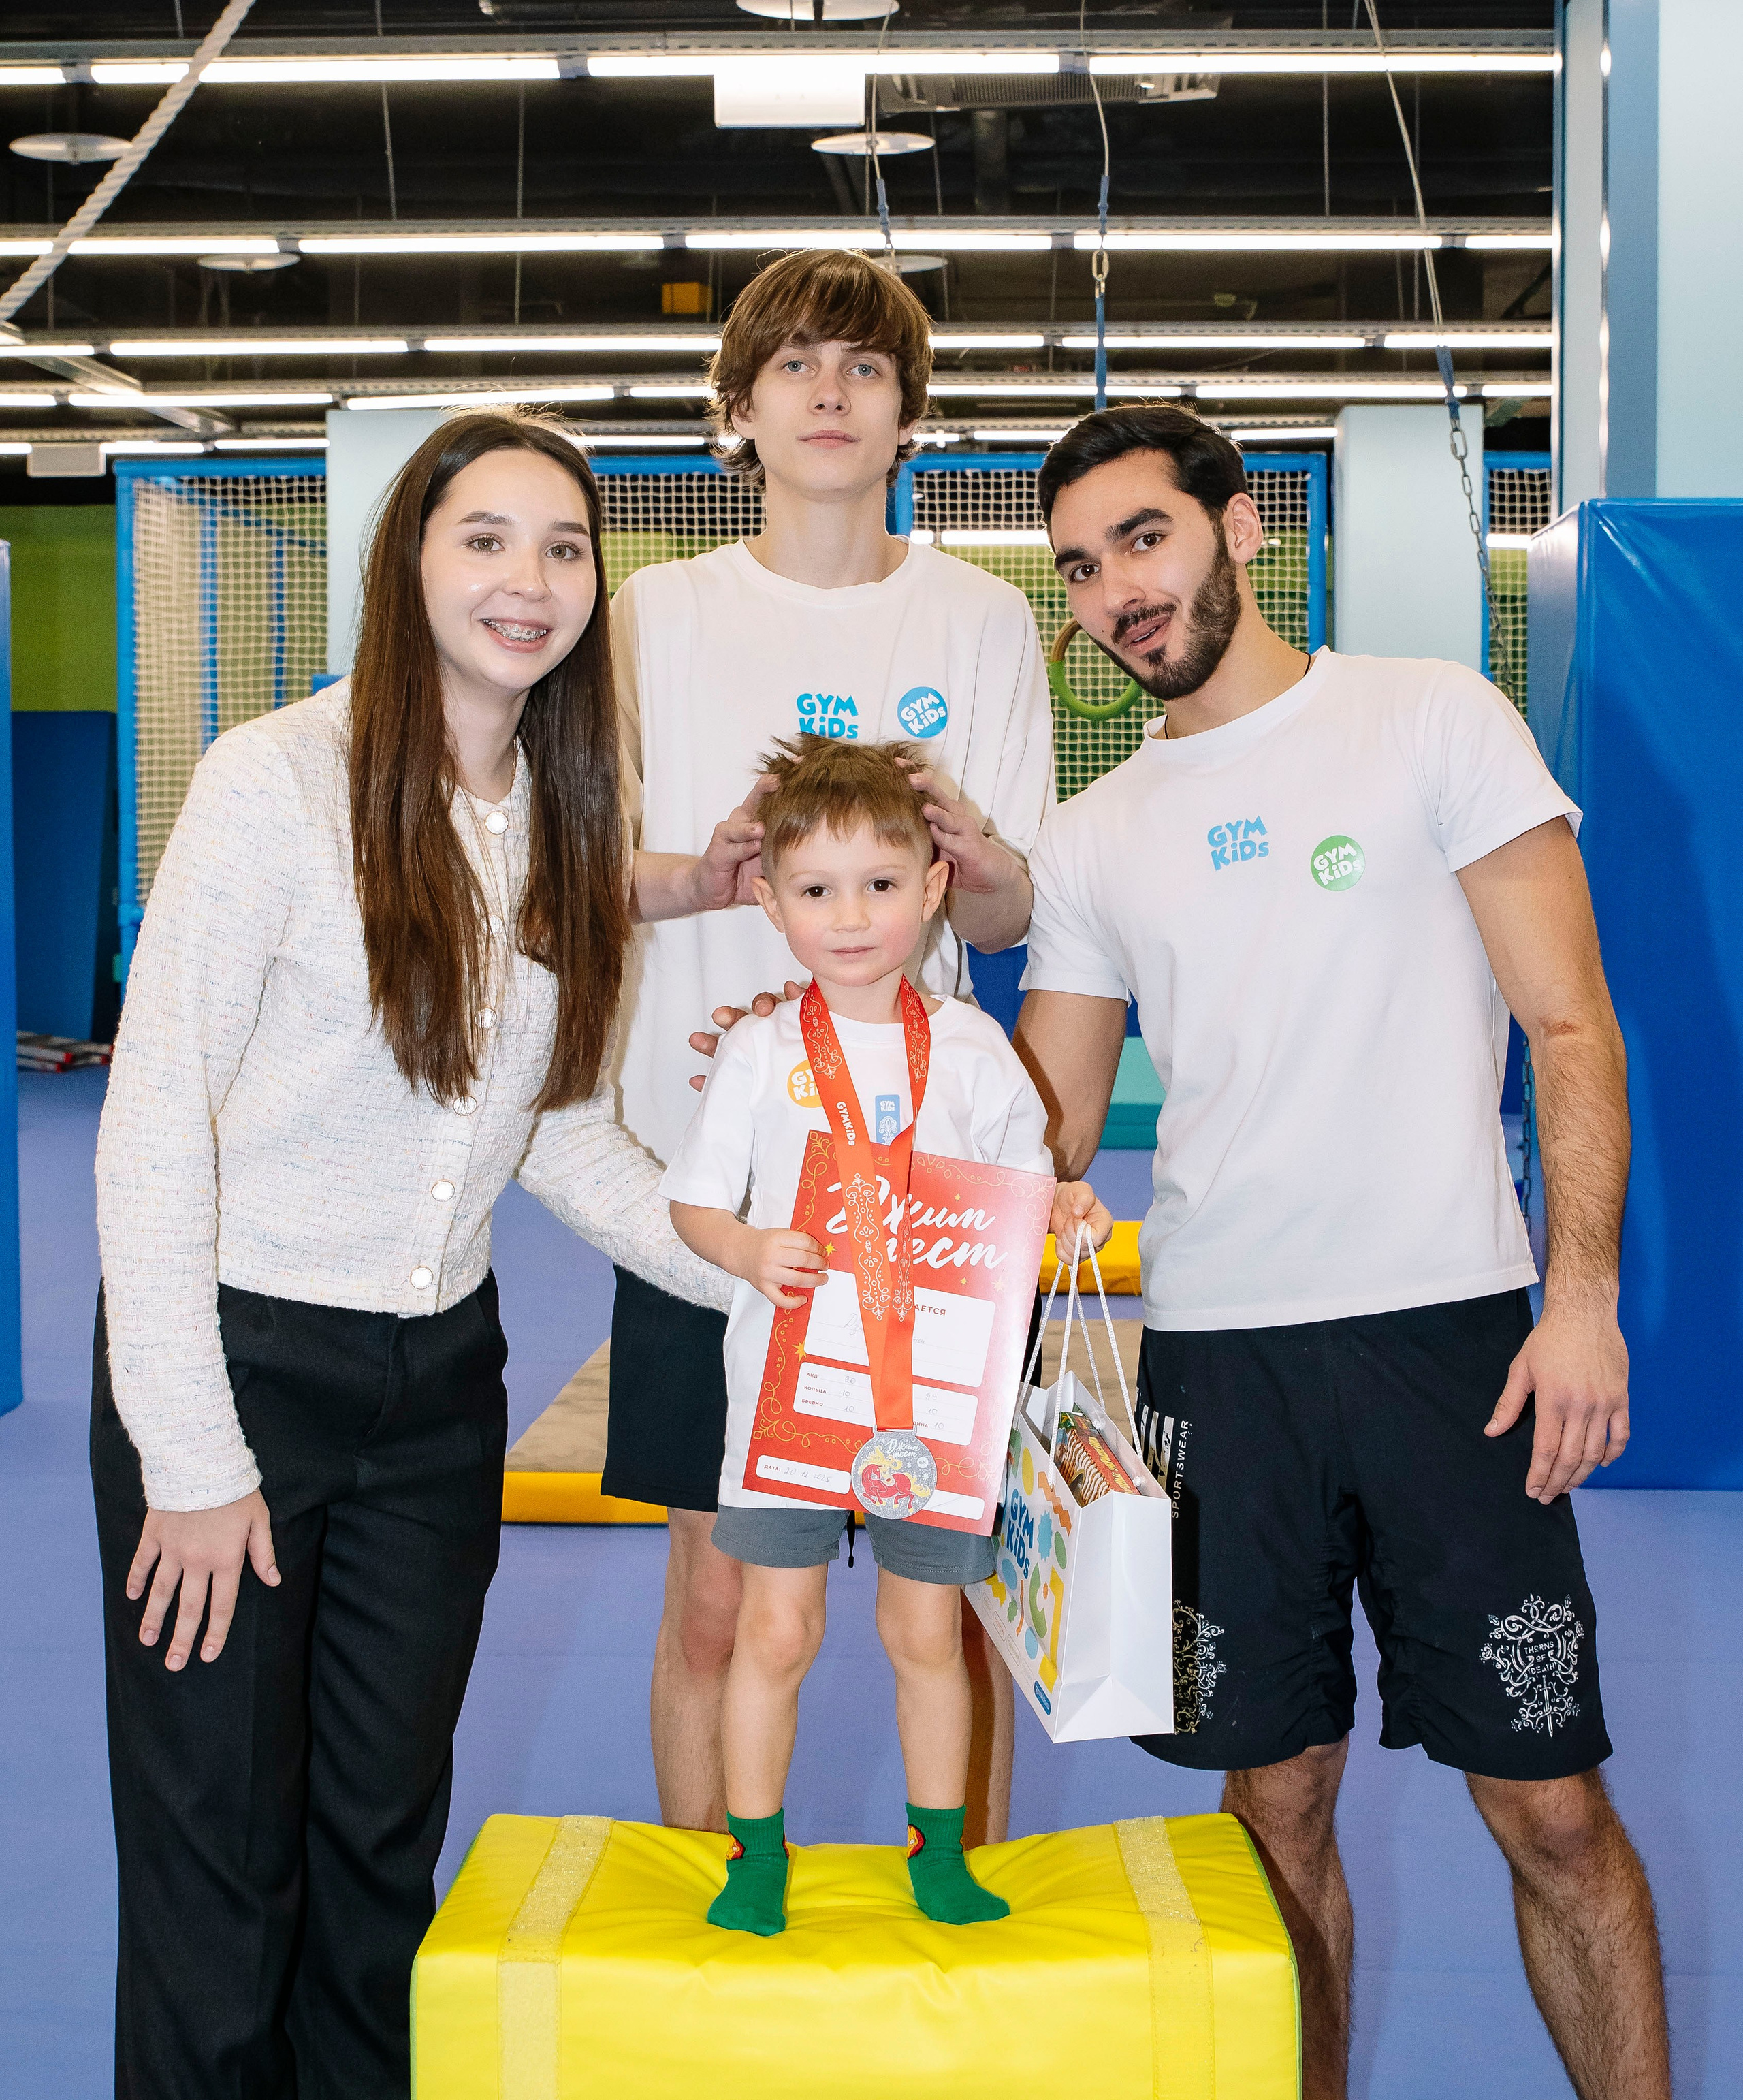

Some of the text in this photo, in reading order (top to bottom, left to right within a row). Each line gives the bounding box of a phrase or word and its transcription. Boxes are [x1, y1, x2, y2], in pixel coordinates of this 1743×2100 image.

[796, 693, 859, 717] GYM
[900, 693, 940, 722] GYM
[1207, 815, 1268, 848] GYM
[1313, 842, 1358, 871] GYM
[791, 1068, 815, 1085] GY
[914, 1303, 946, 1316] АЕТСЯ
[803, 1385, 827, 1394] КОЛЬЦА
[801, 1399, 824, 1407] БРЕВНО
[1172, 1420, 1189, 1519] SPORTSWEAR
[1010, 1488, 1034, 1549] GYM
[1524, 1641, 1554, 1654] THORNS
[1536, 1654, 1546, 1662] OF
[1530, 1662, 1556, 1675] DEATH
